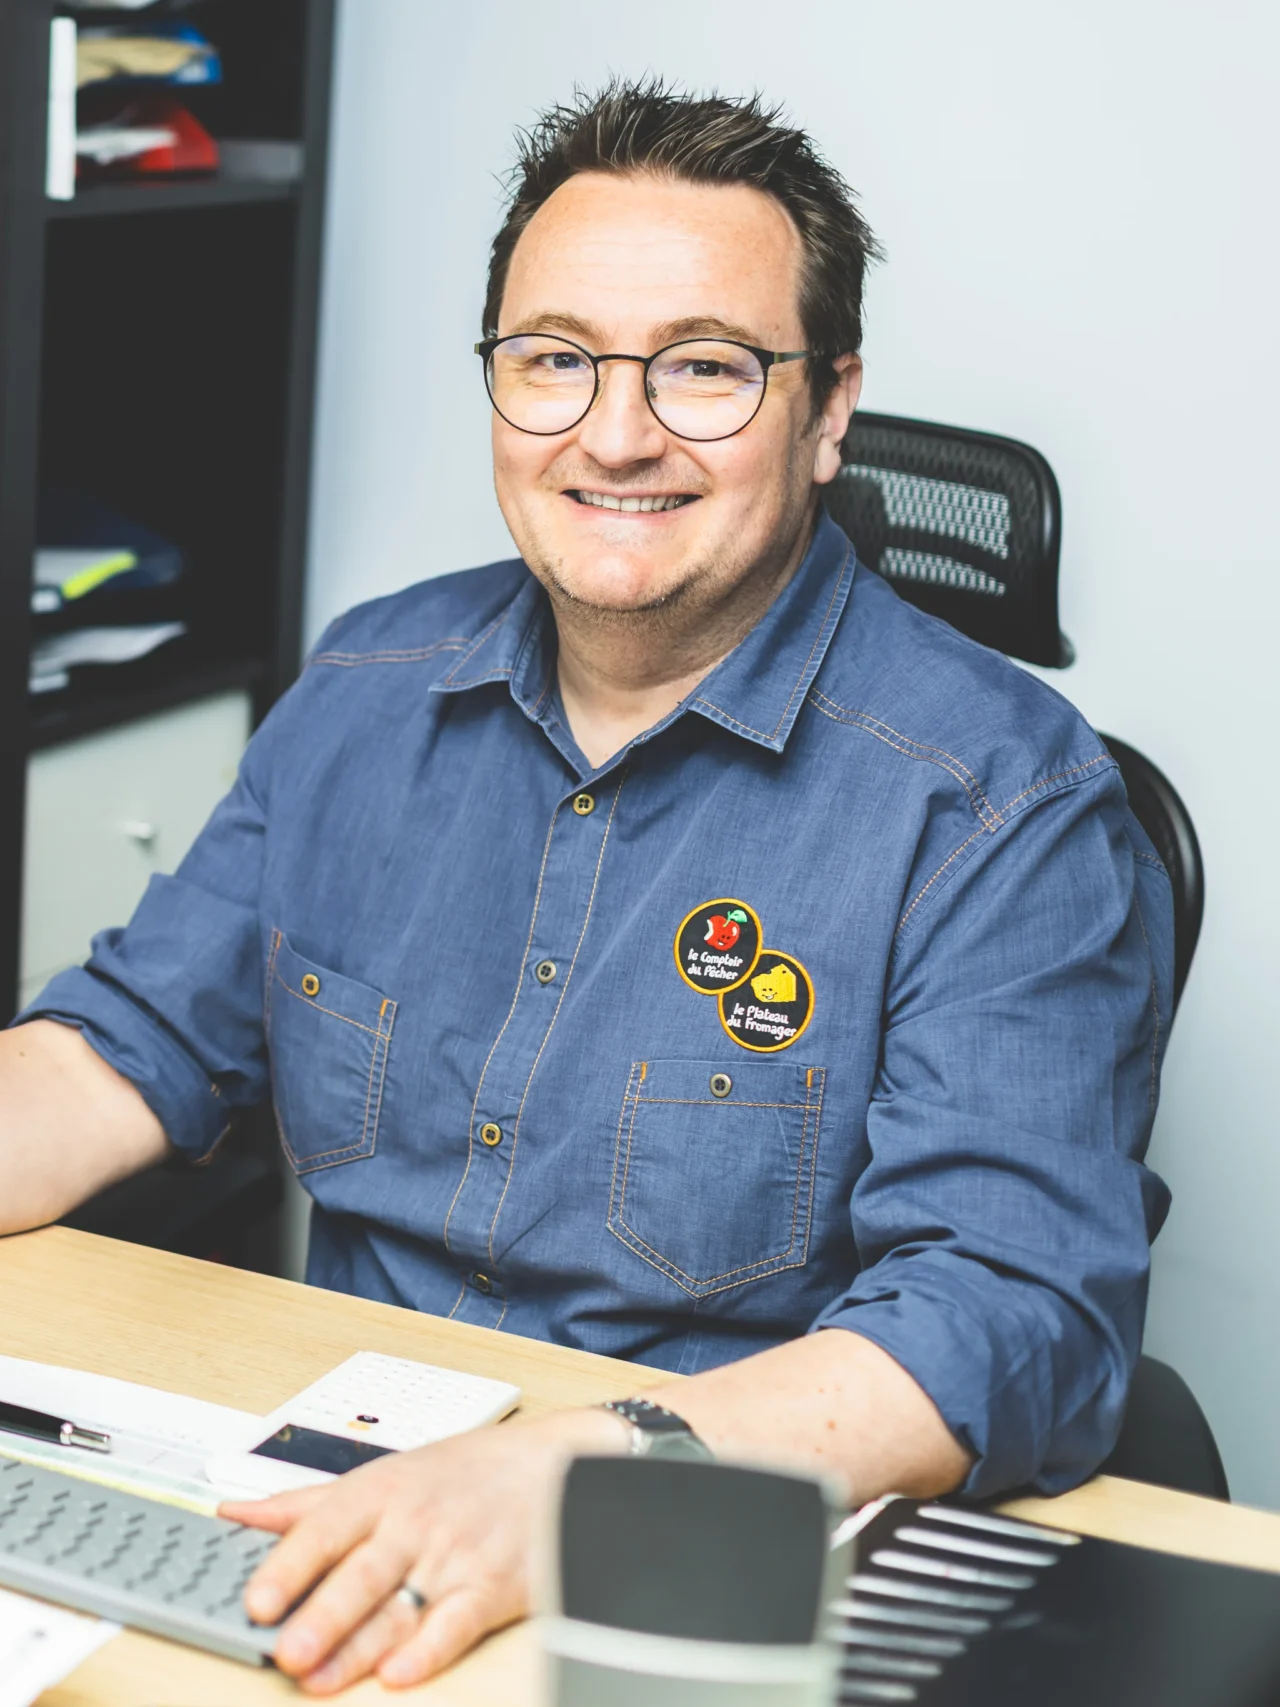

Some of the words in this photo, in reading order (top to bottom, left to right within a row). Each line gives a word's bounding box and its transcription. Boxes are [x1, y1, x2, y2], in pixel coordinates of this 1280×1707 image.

[700, 951, 744, 968] Comptoir
[687, 963, 702, 976] du
[704, 964, 739, 980] Pêcher
[746, 1005, 790, 1025] Plateau
[726, 1014, 742, 1028] du
[745, 1017, 798, 1041] Fromager
